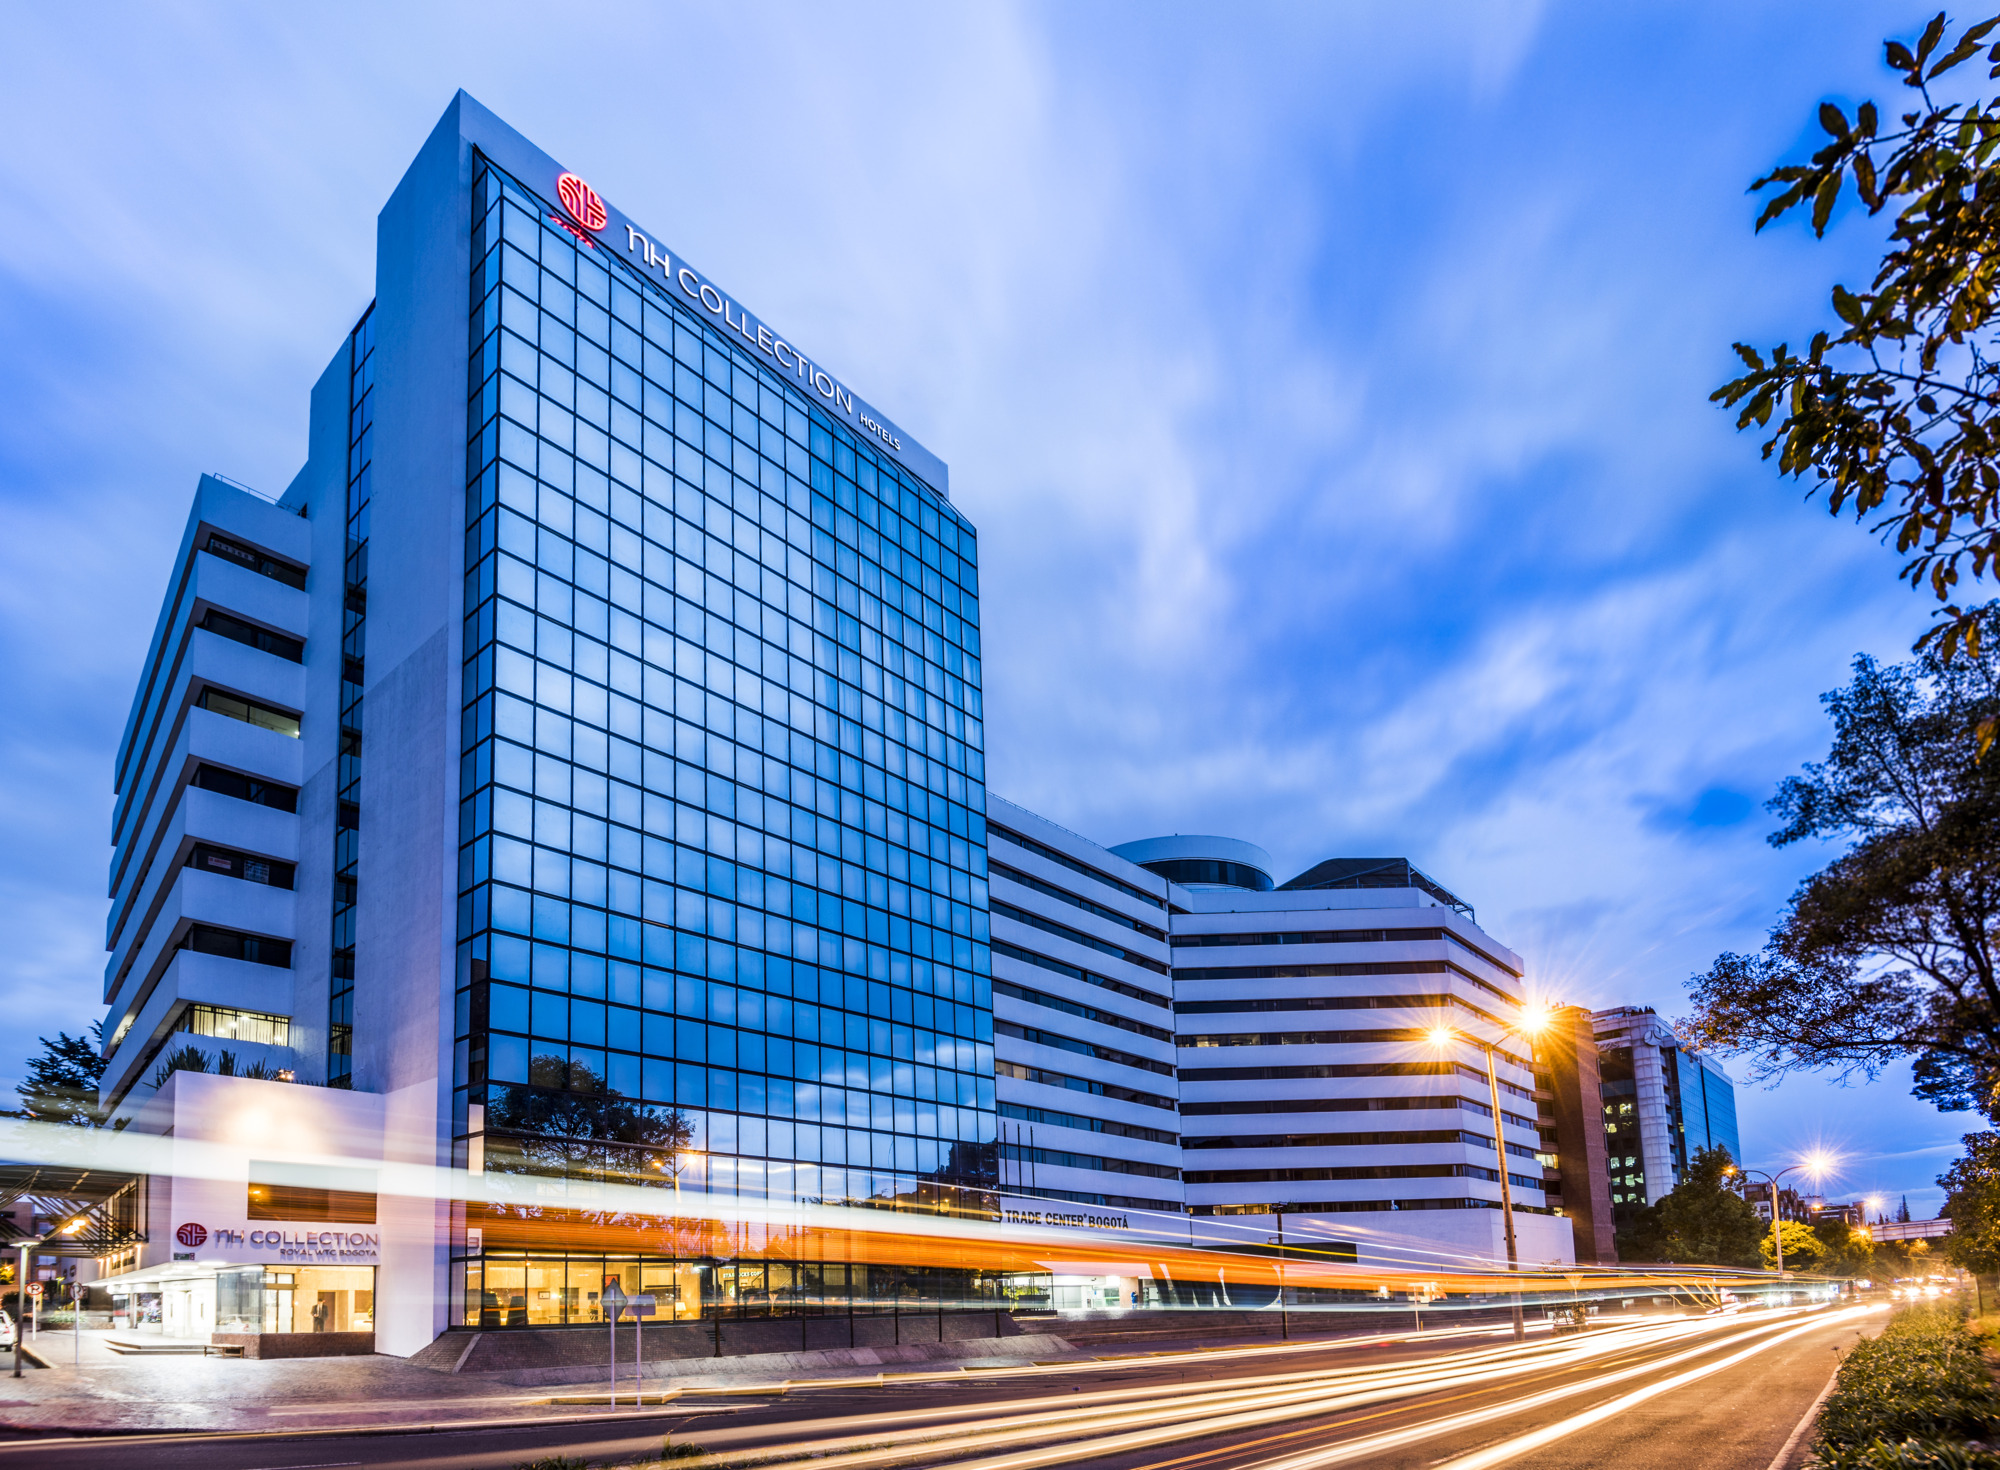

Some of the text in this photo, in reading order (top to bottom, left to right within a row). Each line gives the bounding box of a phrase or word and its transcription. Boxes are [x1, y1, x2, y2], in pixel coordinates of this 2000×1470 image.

[678, 267, 853, 415] COLLECTION
[860, 411, 901, 451] HOTELS
[1005, 1209, 1042, 1225] TRADE
[1088, 1214, 1129, 1230] BOGOTÁ
[250, 1229, 379, 1246] COLLECTION
[315, 1249, 336, 1257] WTC
